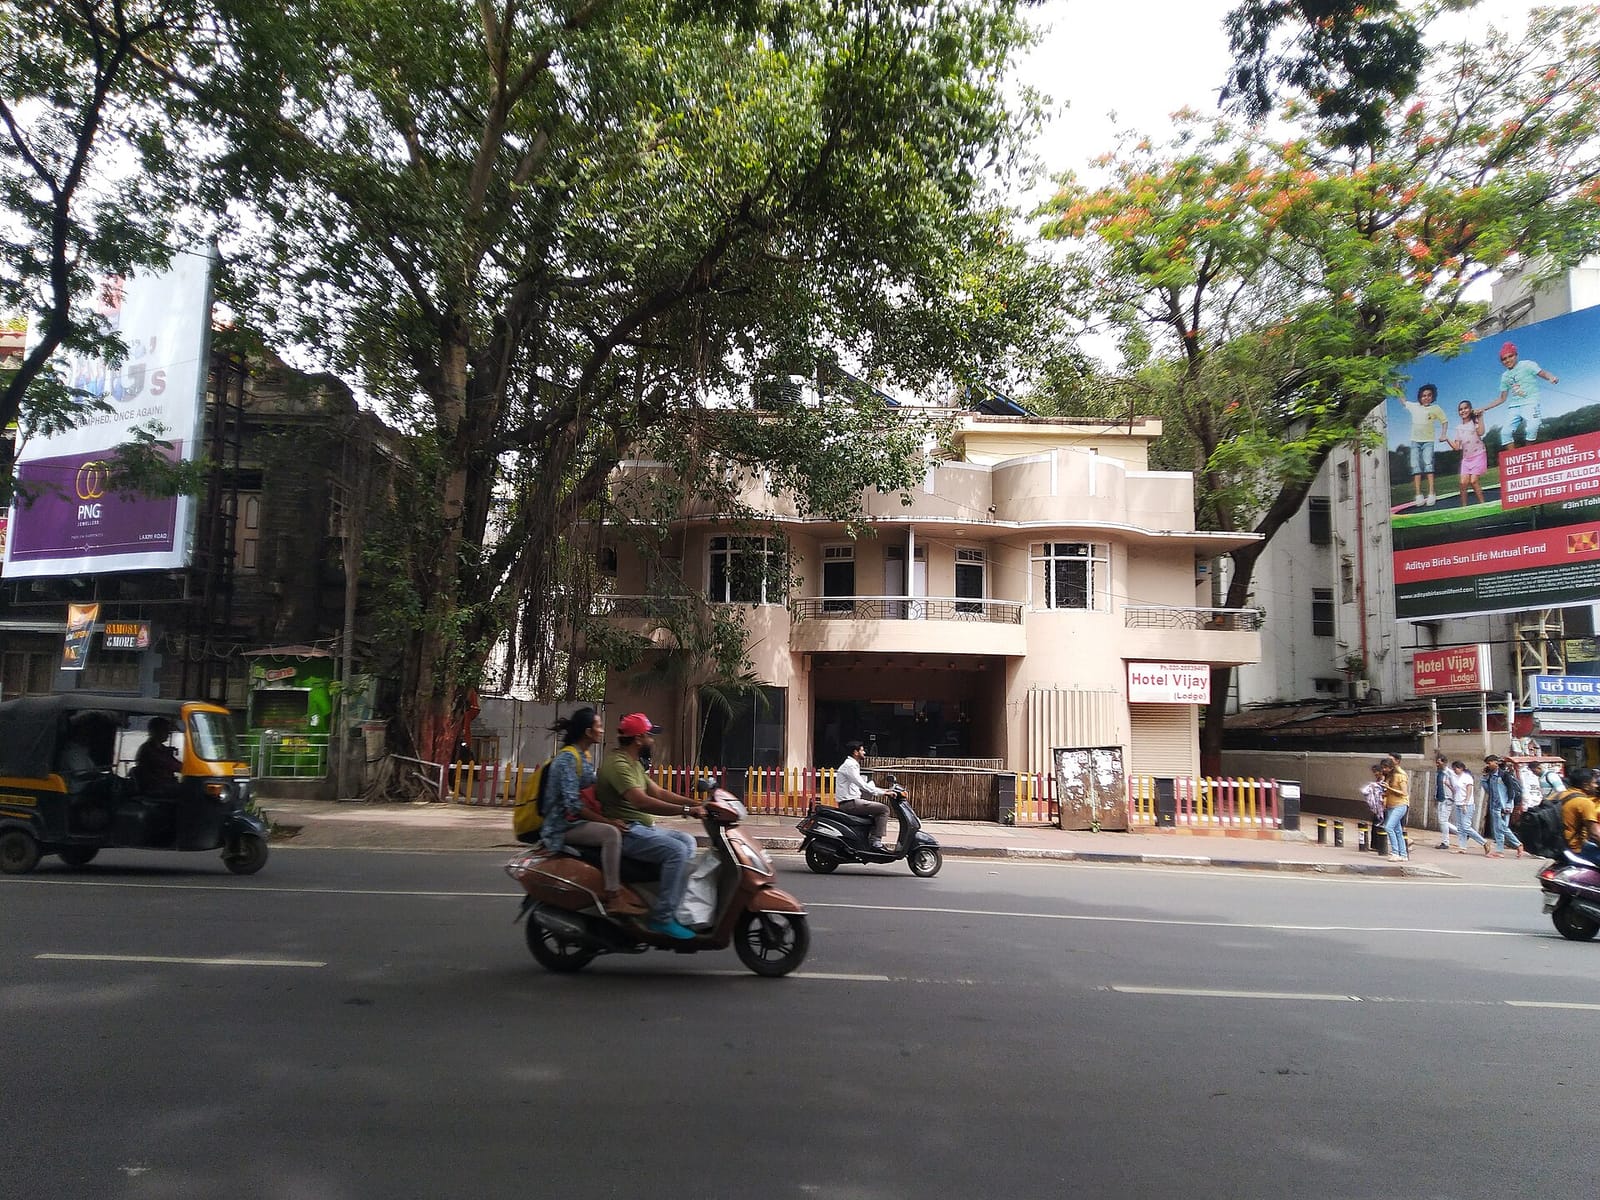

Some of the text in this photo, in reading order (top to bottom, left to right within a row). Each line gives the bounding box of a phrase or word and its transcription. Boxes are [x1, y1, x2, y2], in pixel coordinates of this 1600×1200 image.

[113, 409, 135, 422] ONCE
[136, 405, 163, 418] AGAIN!
[1505, 444, 1578, 466] INVEST IN ONE.
[1506, 465, 1525, 476] GET
[1525, 460, 1545, 472] THE
[1547, 451, 1595, 468] BENEFITS
[1510, 479, 1535, 489] MULTI
[1537, 473, 1563, 485] ASSET
[1508, 480, 1599, 502] EQUITY DEBT GOLD
[77, 503, 102, 520] PNG
[1405, 543, 1546, 571] Aditya Birla Sun Life Mutual Fund
[105, 623, 138, 635] SAMOSA
[1416, 655, 1476, 674] Hotel Vijay
[1132, 673, 1208, 690] Hotel Vijay
[1450, 672, 1477, 684] (Lodge)
[1540, 678, 1564, 692] पर्ल
[1566, 681, 1594, 692] पान
[1174, 692, 1207, 701] (Lodge)
